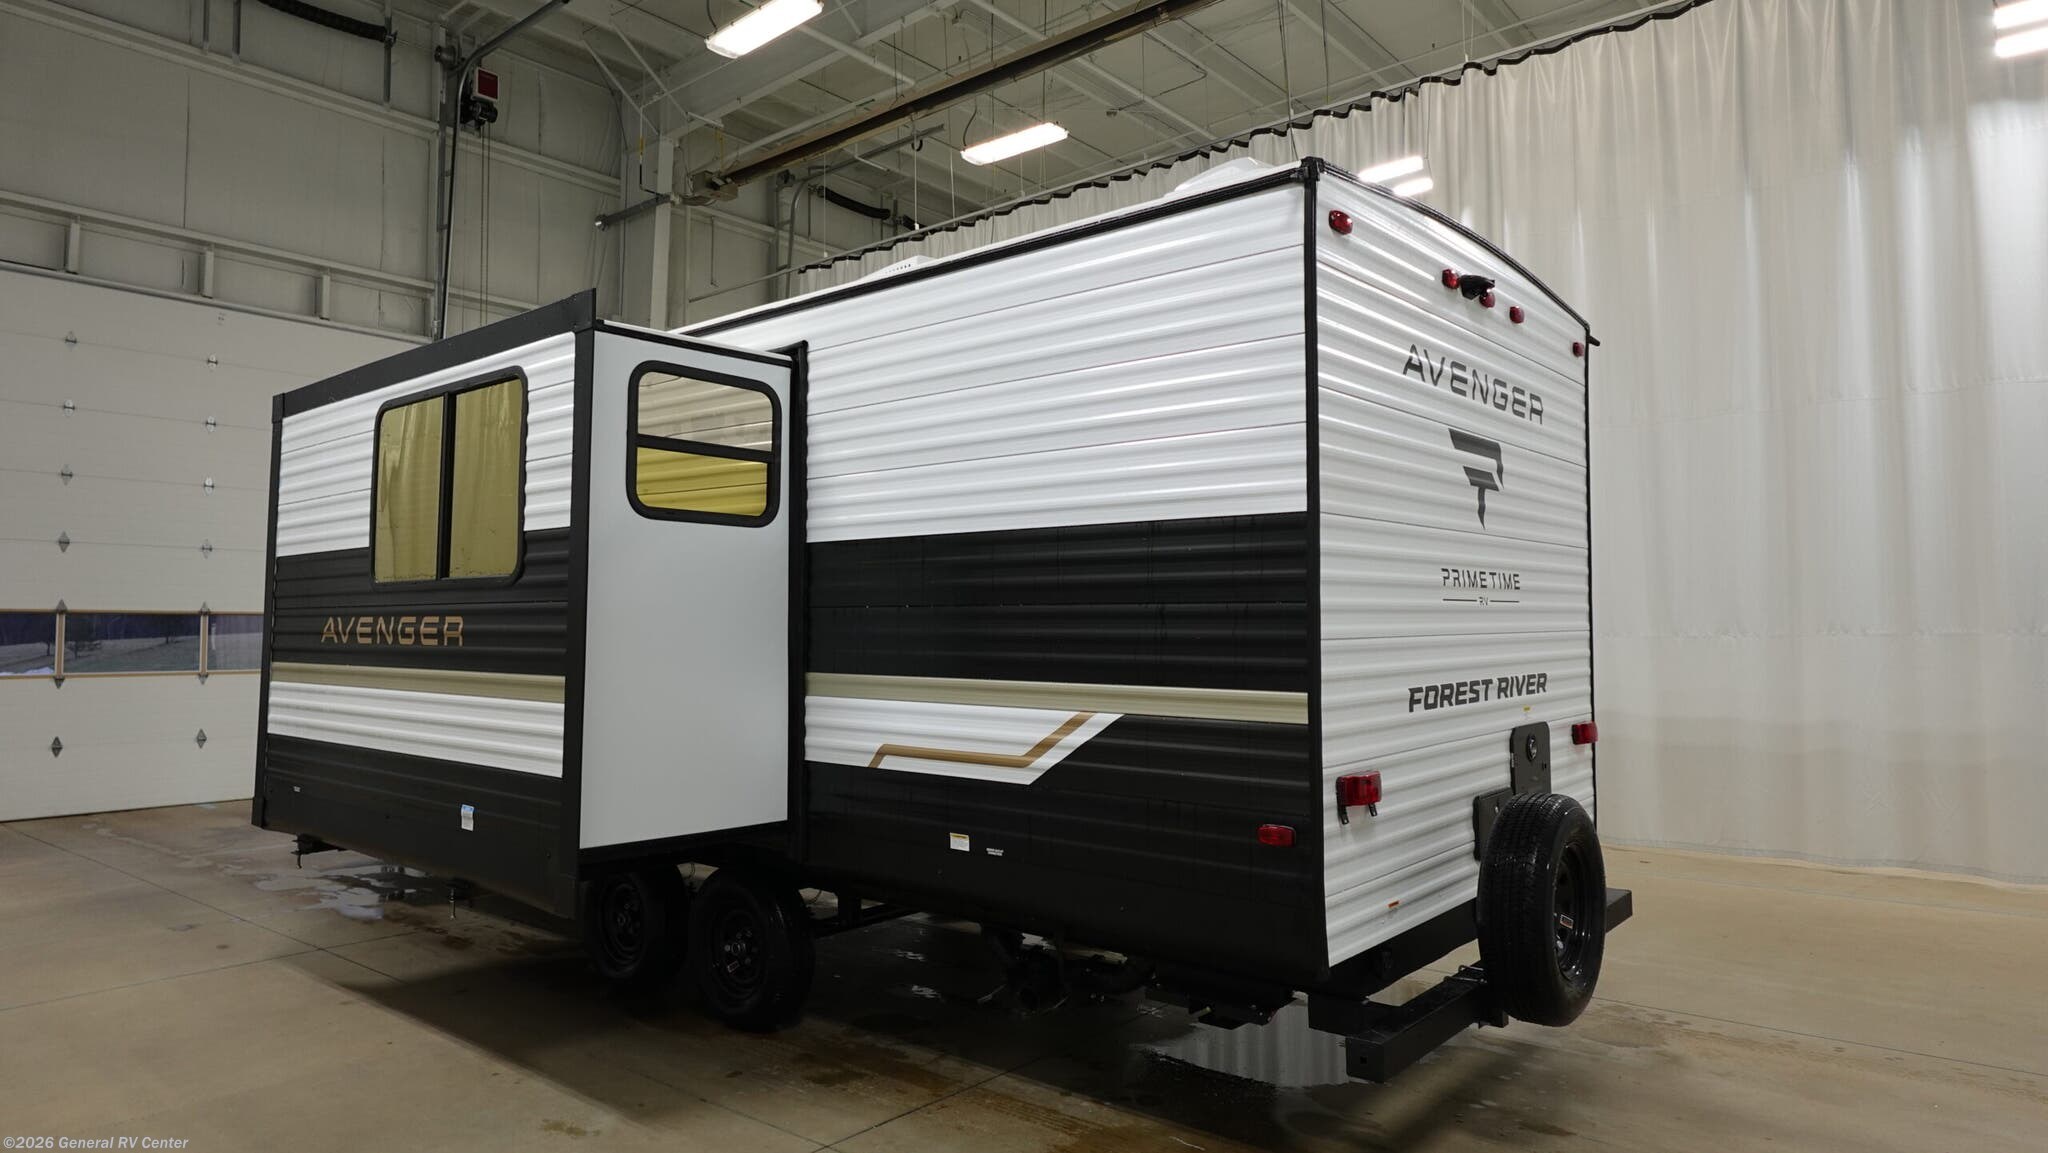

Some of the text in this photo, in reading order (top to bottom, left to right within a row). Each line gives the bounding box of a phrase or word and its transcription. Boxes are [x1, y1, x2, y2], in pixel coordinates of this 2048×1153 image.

[1403, 344, 1543, 424] AVENGER
[321, 616, 464, 647] AVENGER
[1408, 672, 1548, 713] FOREST RIVER
